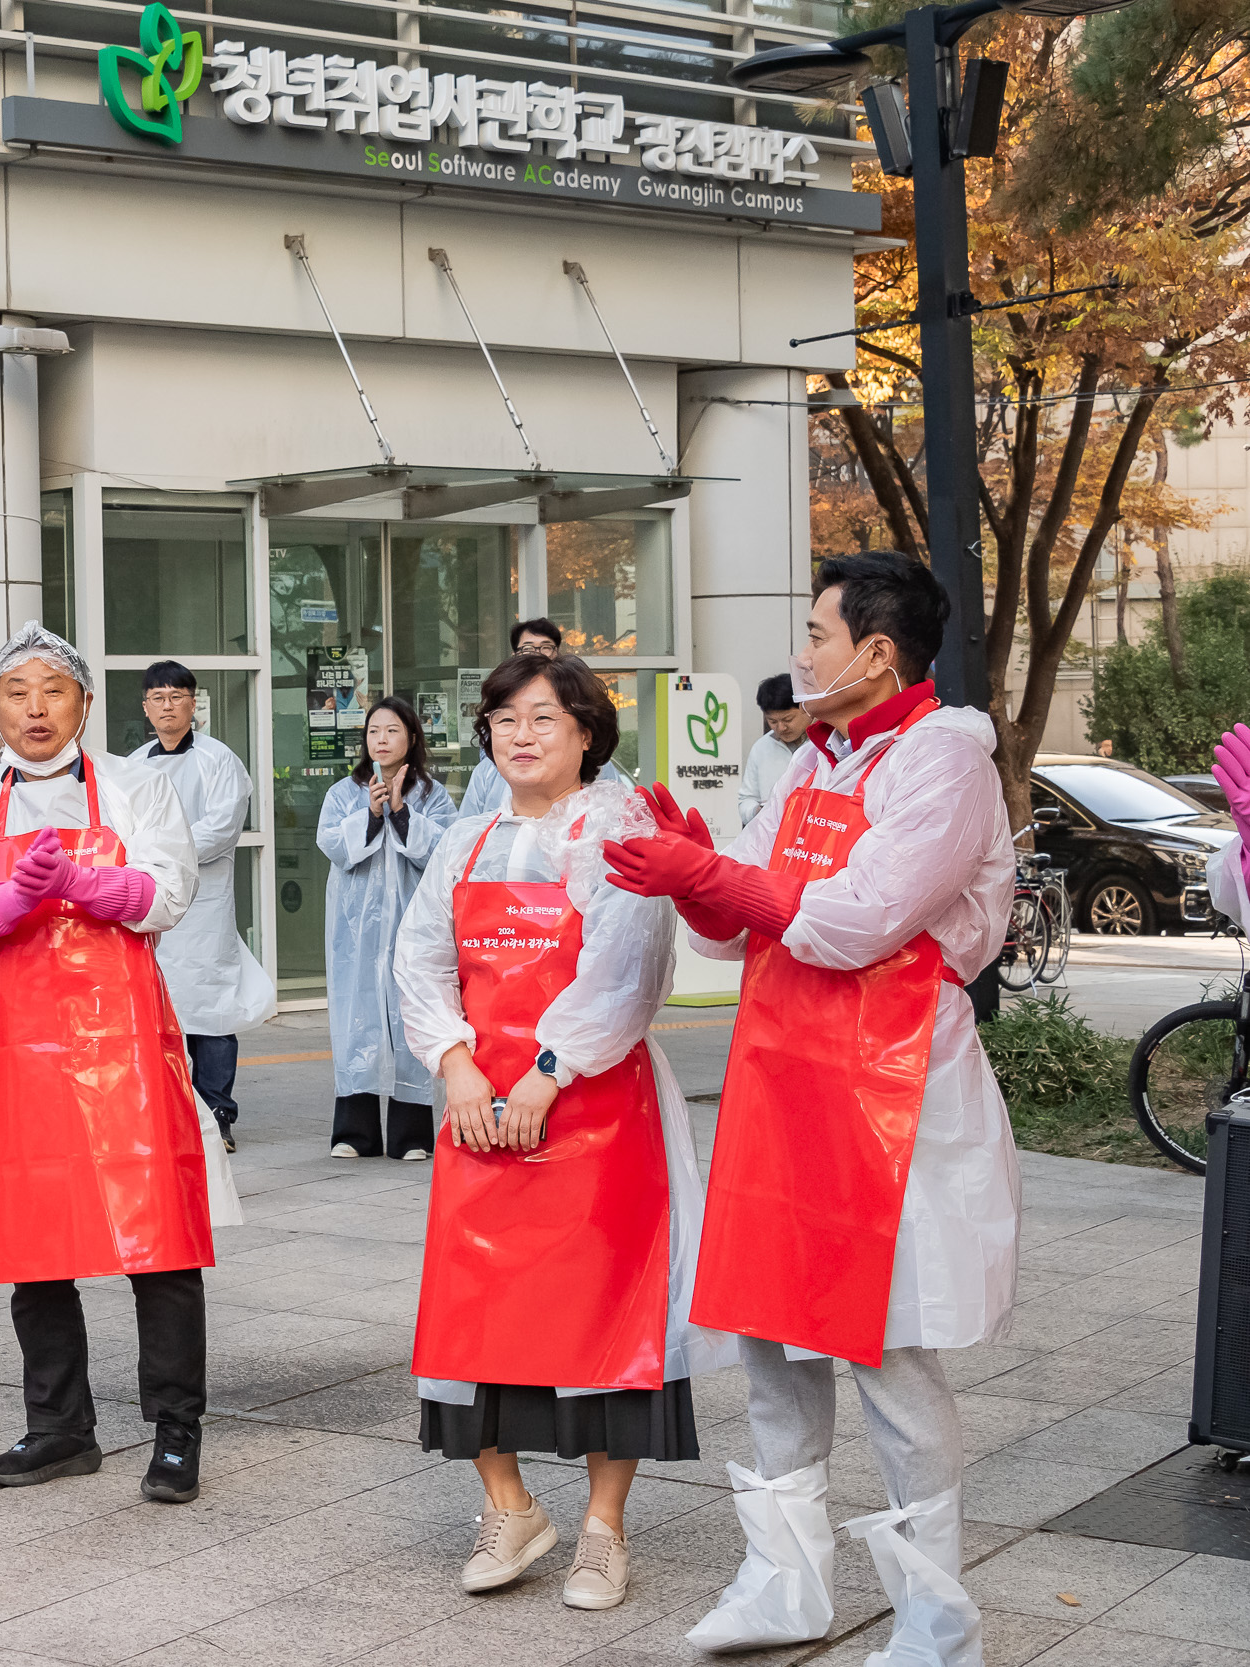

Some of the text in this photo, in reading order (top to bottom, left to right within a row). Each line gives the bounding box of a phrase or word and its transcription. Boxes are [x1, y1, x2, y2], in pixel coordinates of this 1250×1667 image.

[209, 39, 820, 184] 청년취업사관학교 광진캠퍼스
[364, 145, 804, 215] Seoul Software ACademy Gwangjin Campus
[497, 927, 516, 935] 2024
